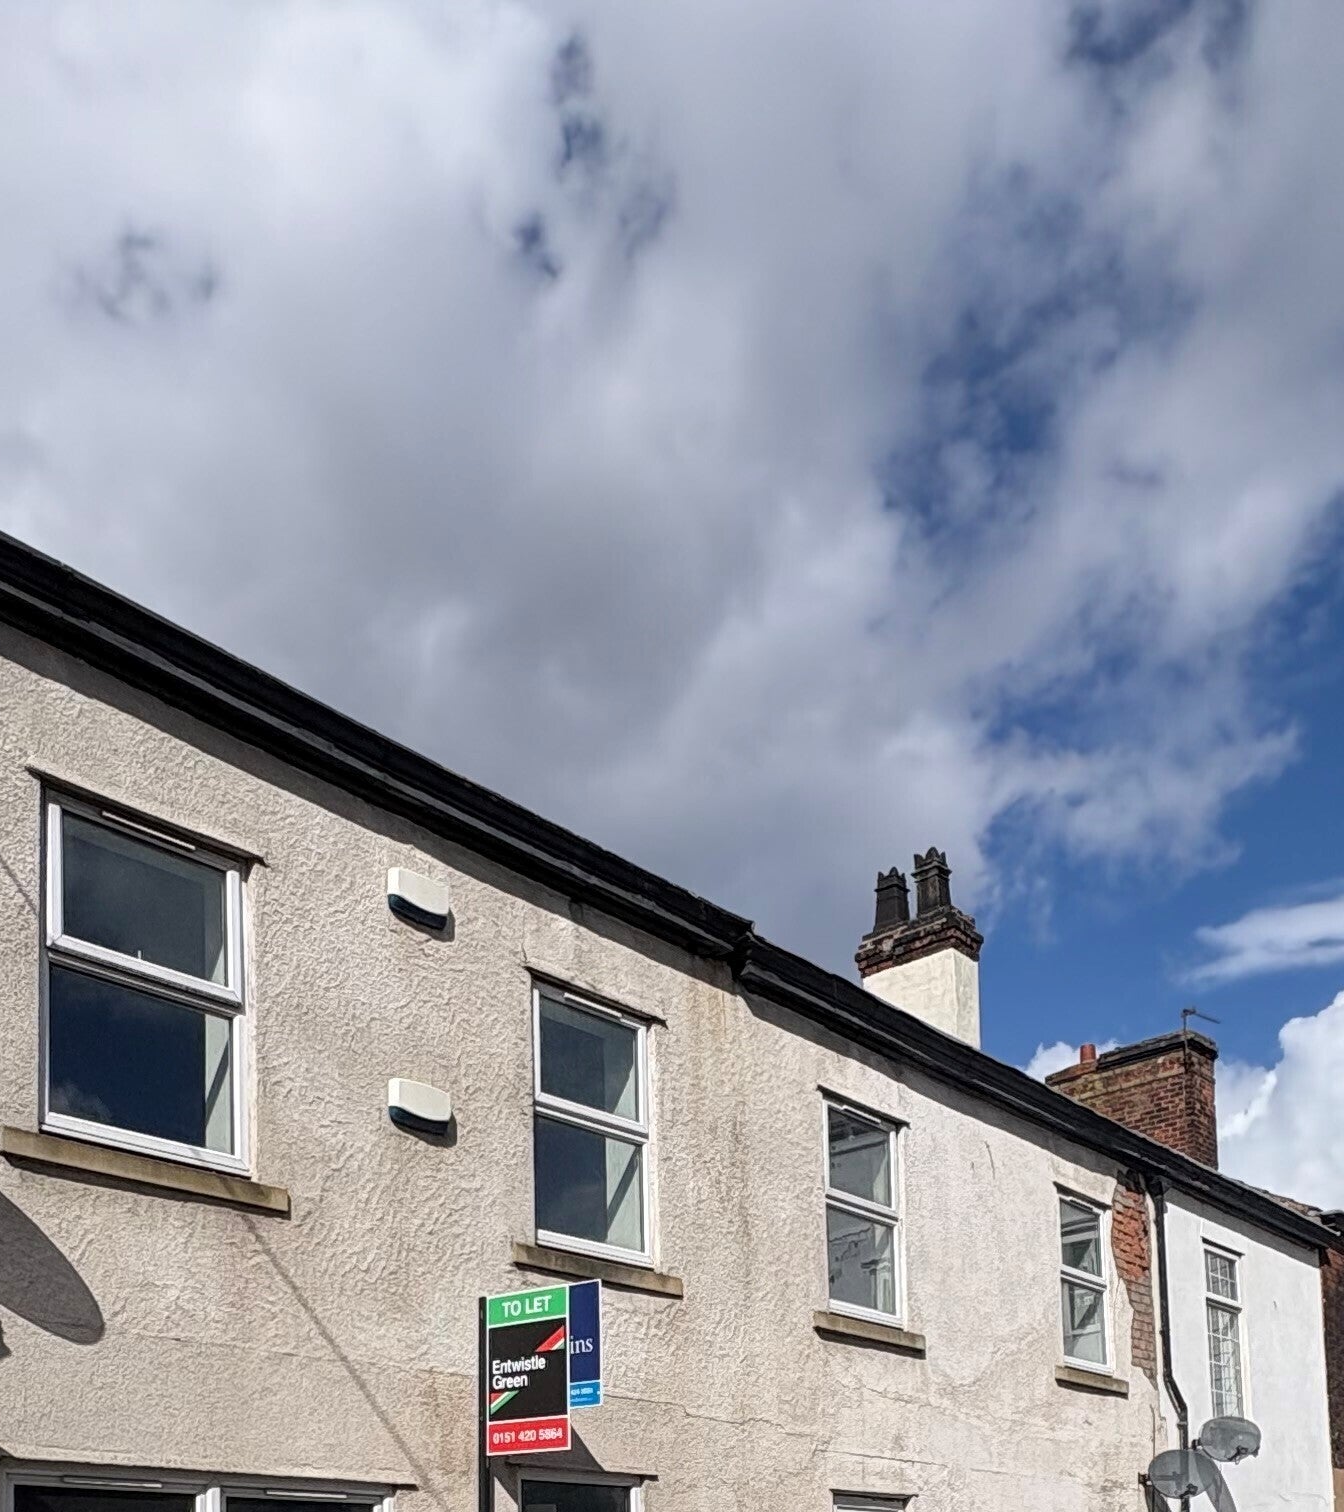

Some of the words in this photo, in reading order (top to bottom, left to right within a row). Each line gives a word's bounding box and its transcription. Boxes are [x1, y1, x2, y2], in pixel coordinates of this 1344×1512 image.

[501, 1299, 522, 1318] TO
[525, 1294, 553, 1314] LET
[492, 1354, 546, 1375] Entwistle
[492, 1374, 528, 1390] Green
[492, 1430, 516, 1445] 0151
